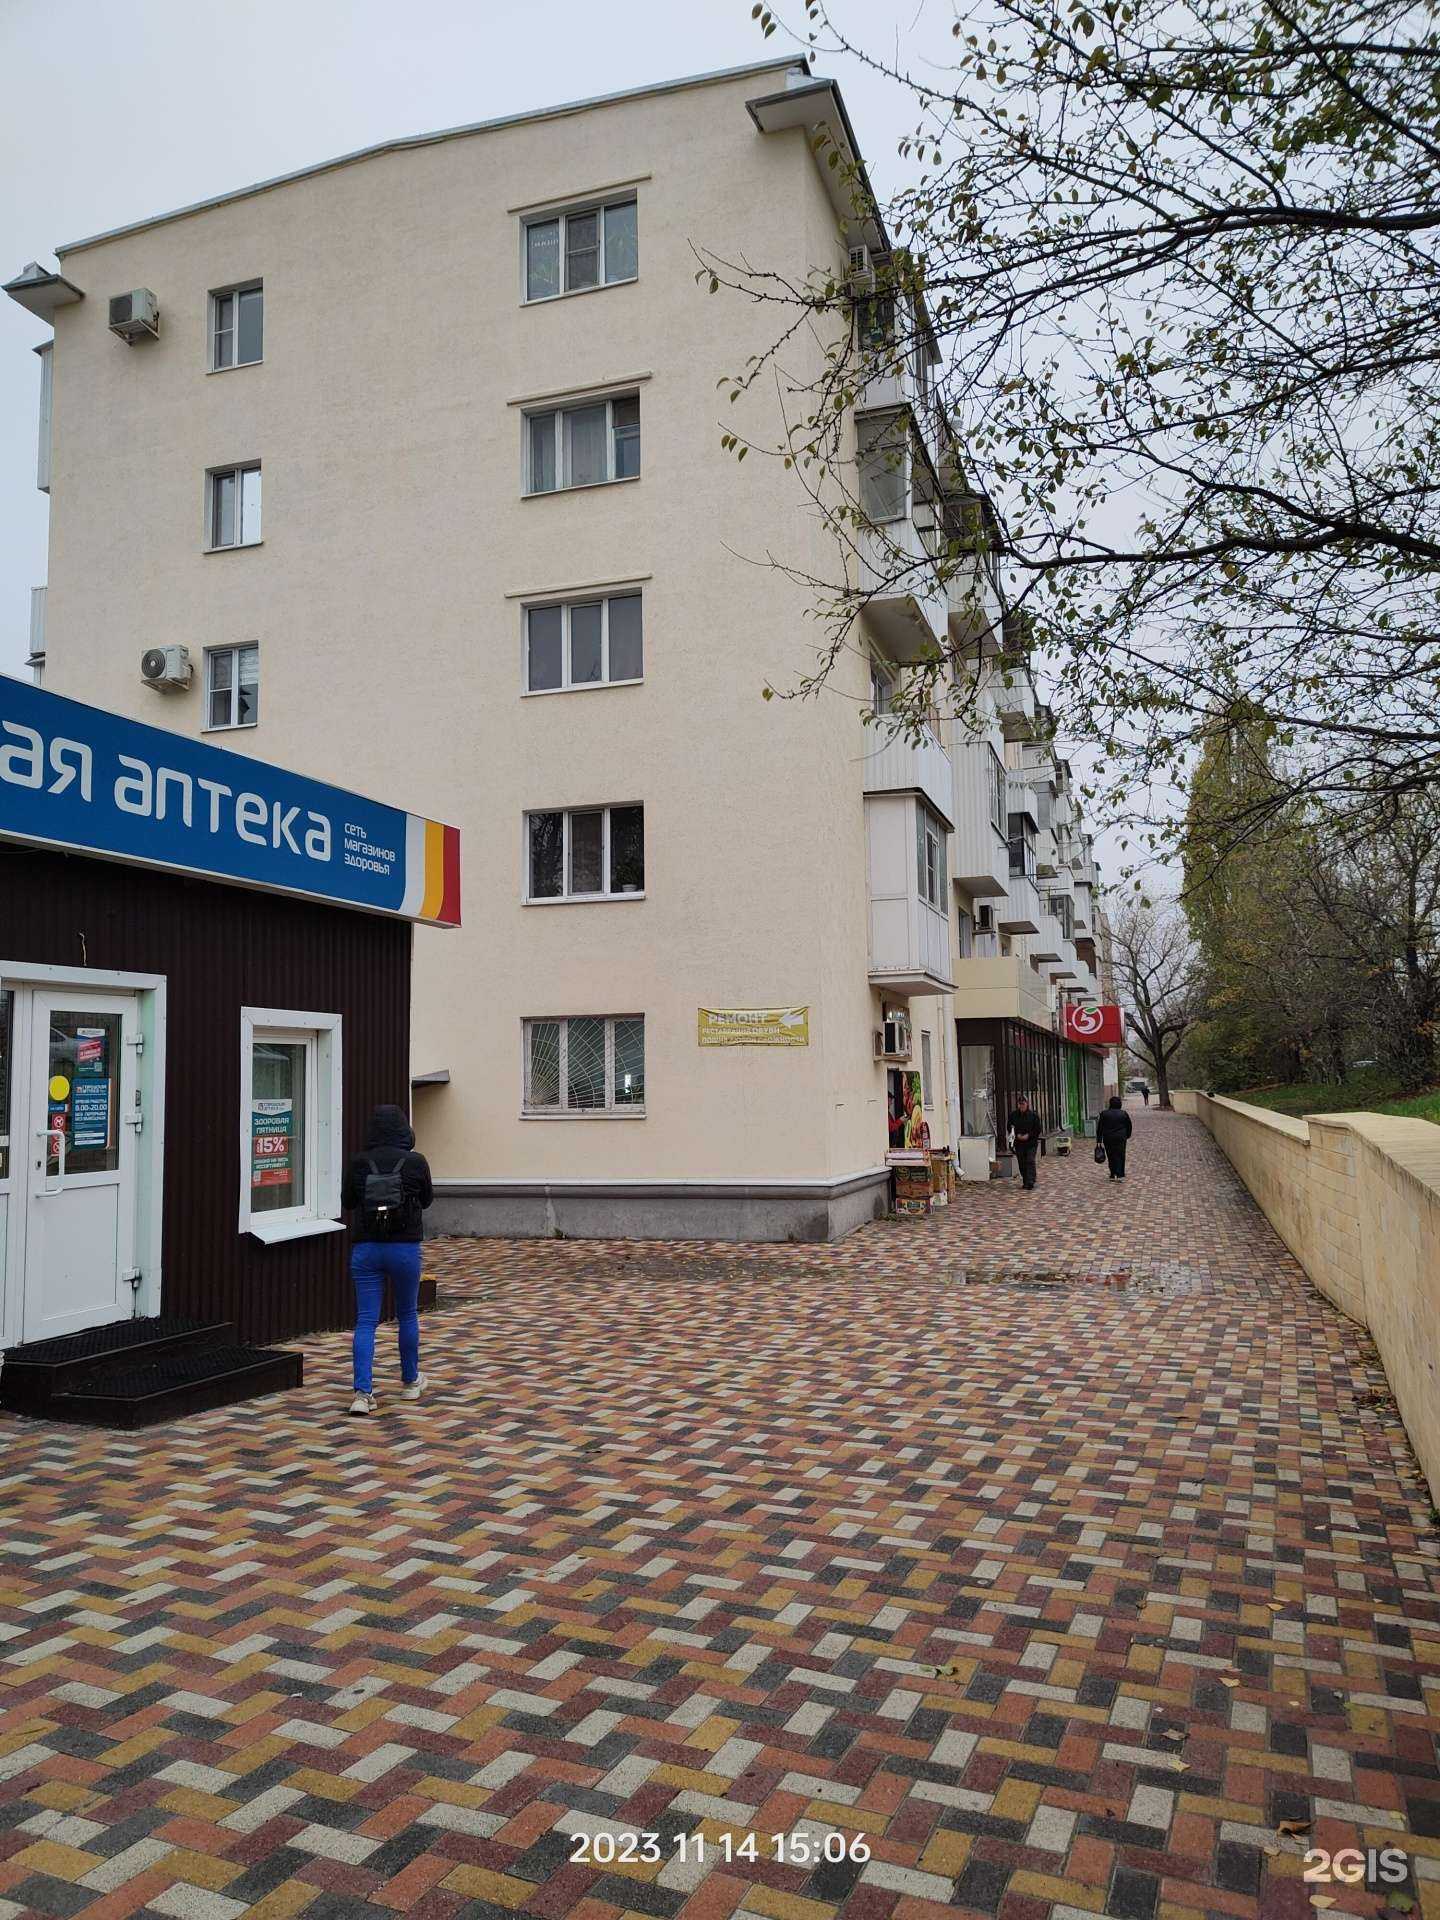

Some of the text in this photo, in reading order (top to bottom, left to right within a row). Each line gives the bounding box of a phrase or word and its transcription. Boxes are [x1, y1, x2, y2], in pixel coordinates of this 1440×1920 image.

[0, 720, 331, 862] ая аптека
[344, 822, 367, 839] сеть
[344, 837, 396, 862] магазинов
[344, 853, 390, 876] здоровья
